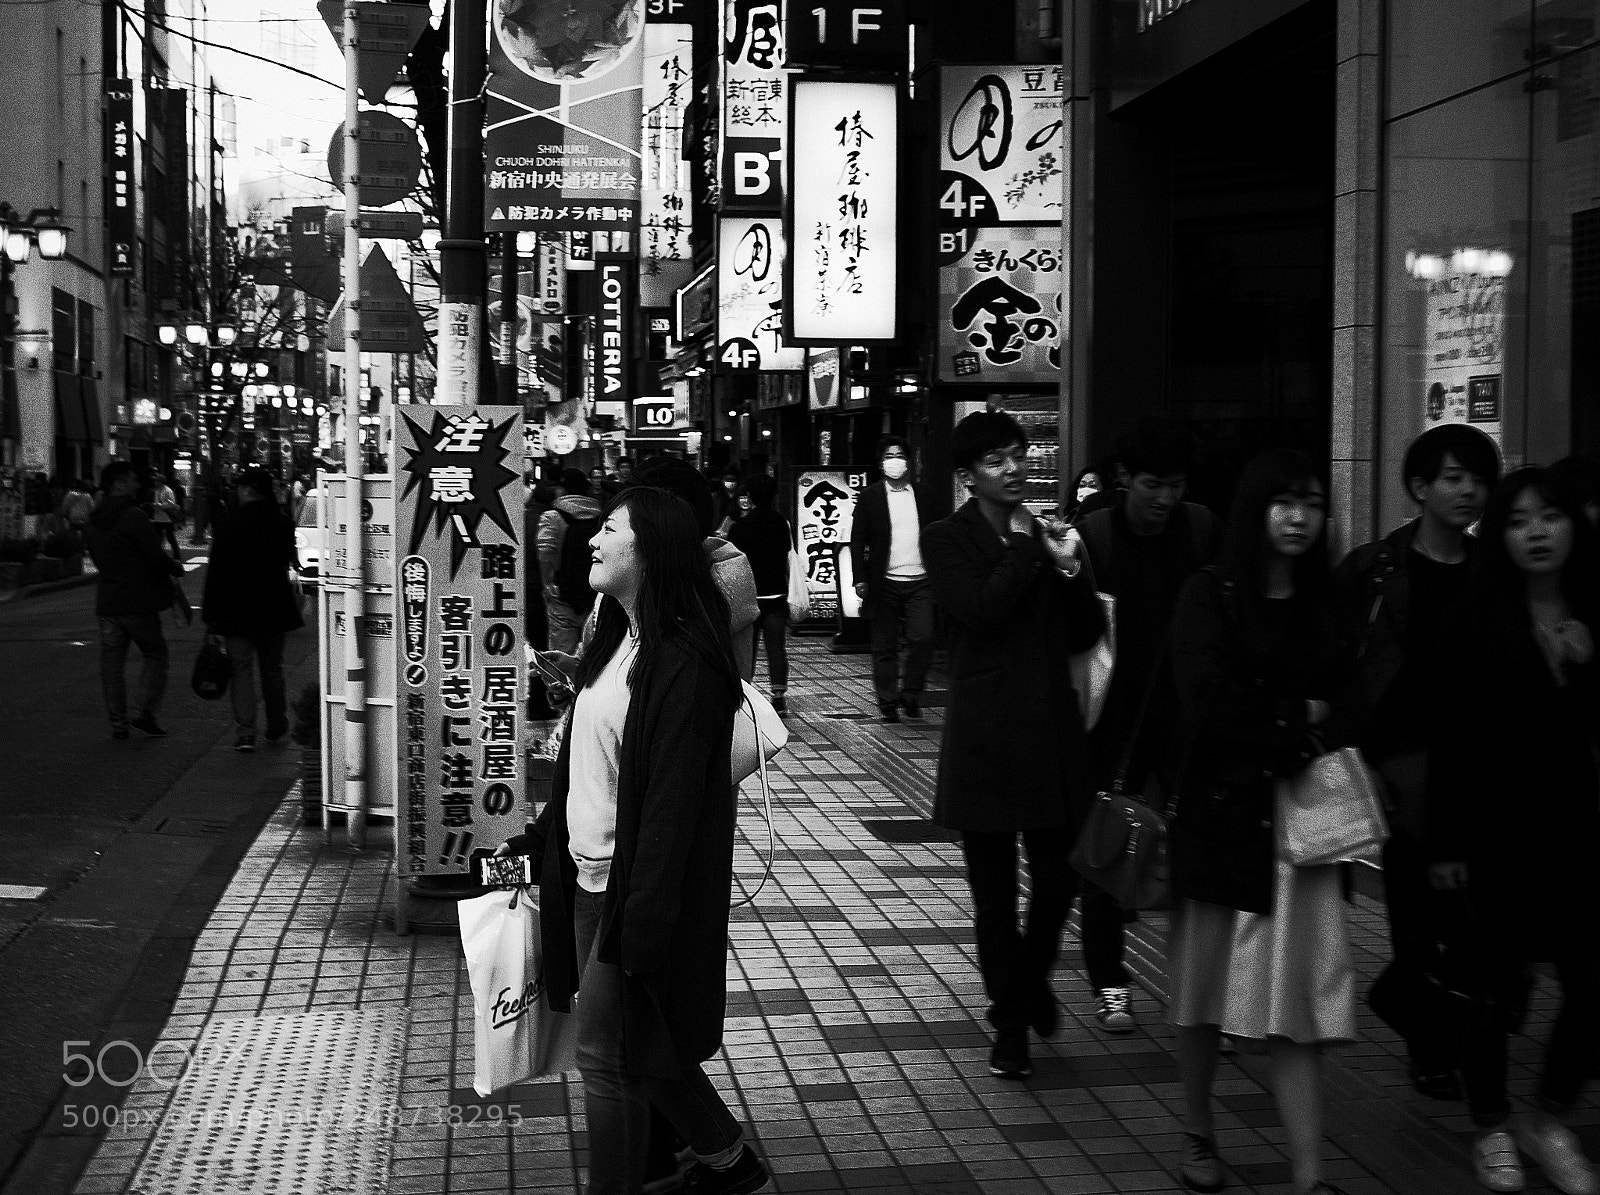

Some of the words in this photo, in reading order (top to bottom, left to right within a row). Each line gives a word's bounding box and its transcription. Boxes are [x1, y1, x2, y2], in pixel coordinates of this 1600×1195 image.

[812, 7, 883, 44] 1F
[538, 144, 589, 154] SHINJUKU
[495, 157, 534, 167] CHUOH
[835, 110, 874, 294] 椿屋珈琲店
[939, 180, 986, 217] 4F
[508, 206, 633, 221] 防犯カメラ作動中
[940, 228, 968, 253] B1
[972, 248, 1062, 272] きんくら
[602, 265, 622, 394] LOTTERIA
[720, 342, 758, 369] 4F
[647, 408, 674, 424] LO
[849, 472, 867, 488] B1
[478, 543, 518, 817] 路上の居酒屋の
